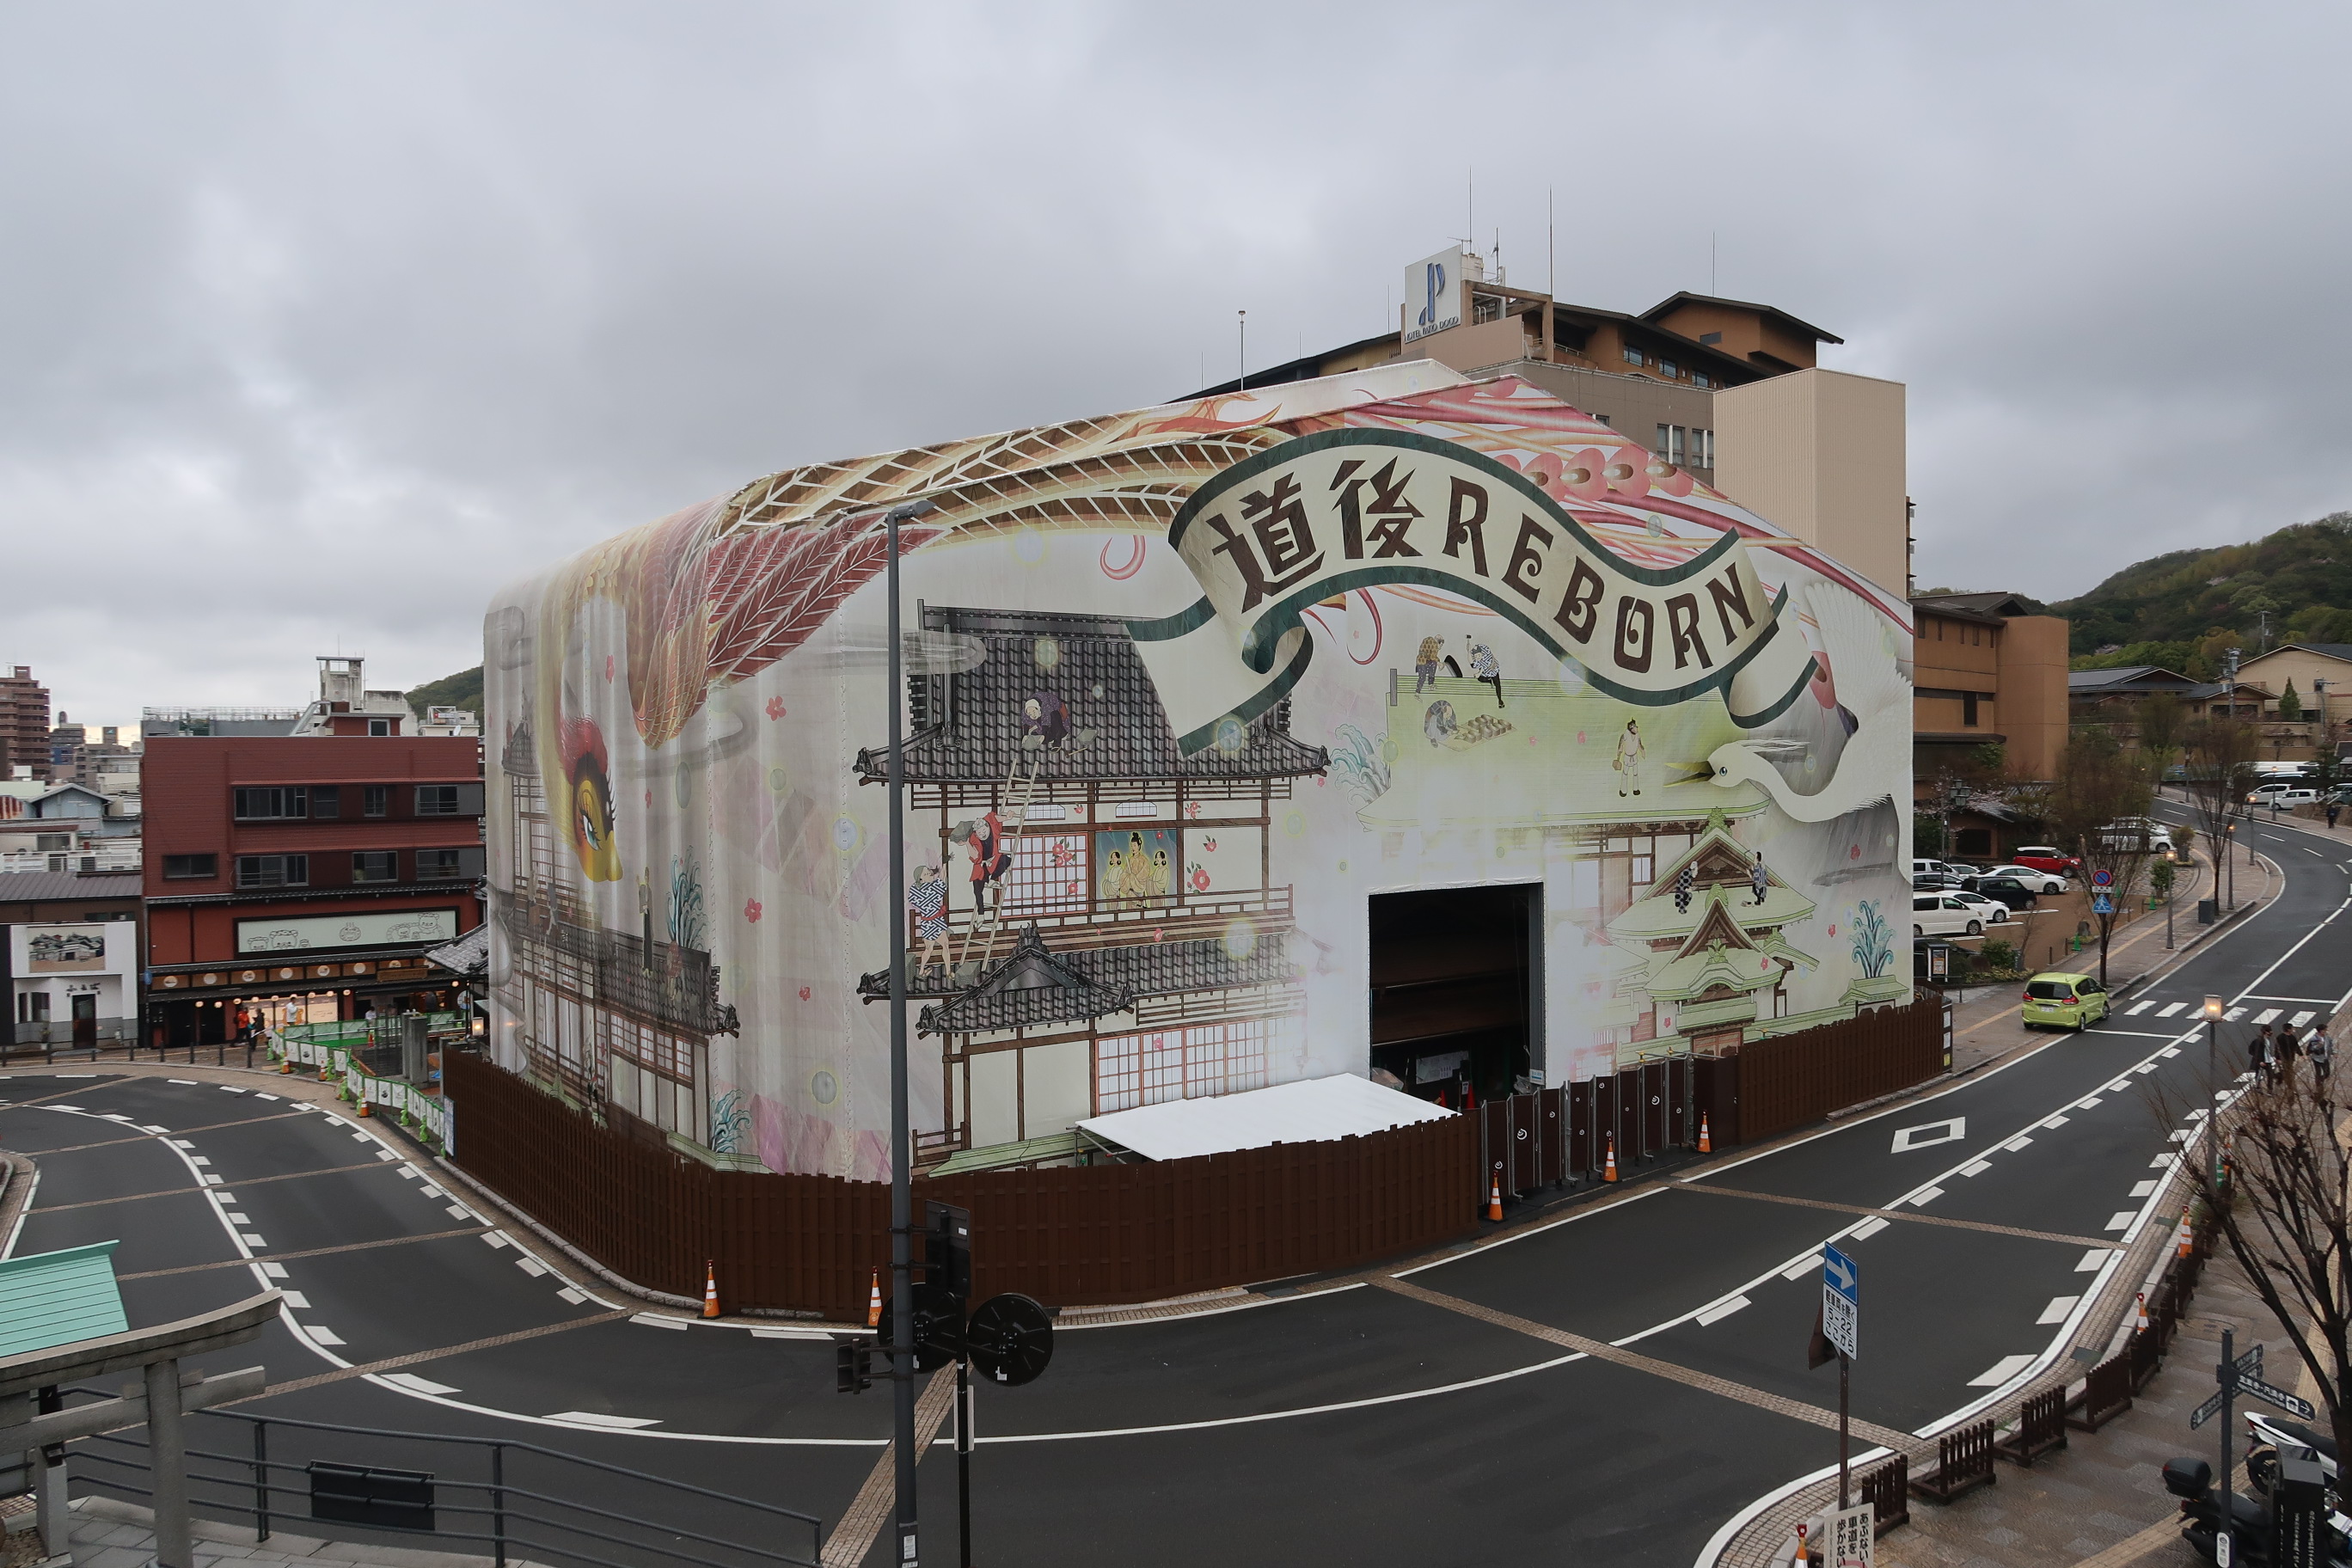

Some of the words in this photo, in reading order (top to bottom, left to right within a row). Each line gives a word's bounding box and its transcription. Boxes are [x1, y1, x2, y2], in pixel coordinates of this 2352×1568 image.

[1404, 330, 1421, 341] HOTEL
[1828, 1307, 1852, 1336] 5-22
[1825, 1321, 1854, 1353] ここから
[1848, 1516, 1858, 1554] 車道を
